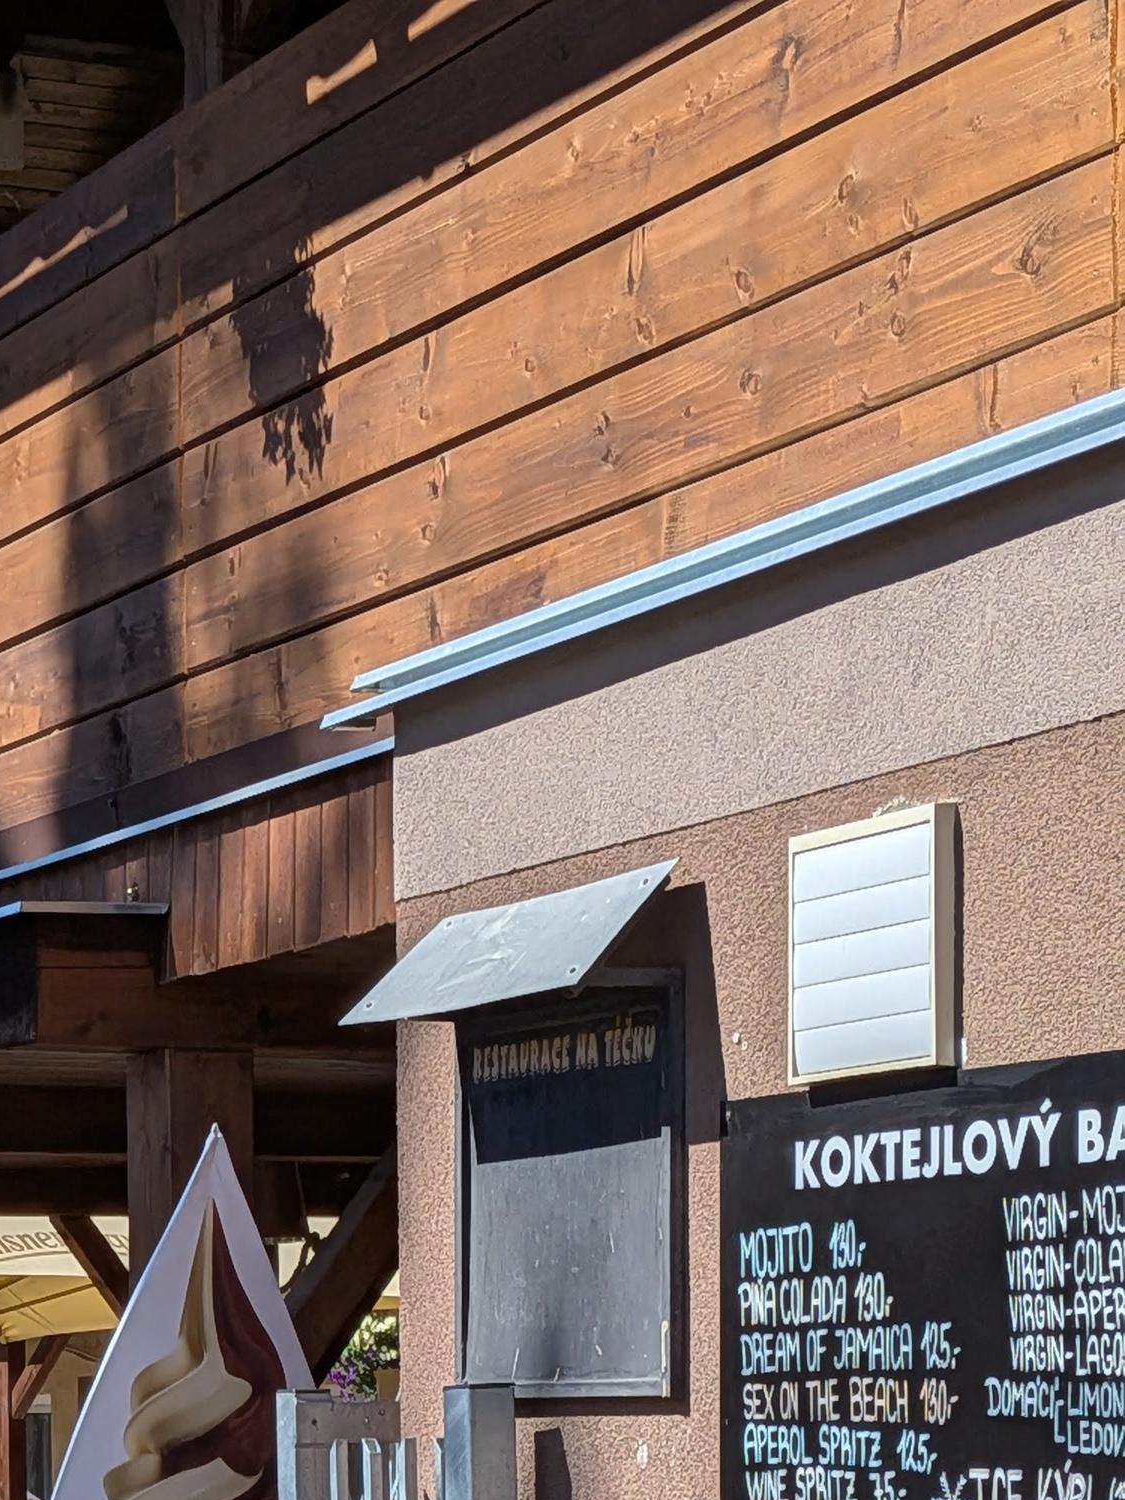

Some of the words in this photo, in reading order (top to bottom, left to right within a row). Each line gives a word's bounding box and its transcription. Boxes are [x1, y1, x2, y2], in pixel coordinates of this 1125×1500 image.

[472, 1033, 571, 1085] RESTAURACE
[575, 1032, 600, 1071] NA
[794, 1097, 1063, 1190] KOKTEJLOVÝ
[739, 1221, 813, 1279] MOJITO
[779, 1274, 847, 1327] COLADA
[739, 1331, 801, 1376] DREAM
[806, 1328, 828, 1372] OF
[833, 1322, 913, 1372] JAMAICA
[742, 1381, 774, 1420] SEX
[779, 1380, 799, 1420] ON
[805, 1377, 841, 1423] THE
[849, 1376, 909, 1424] BEACH
[743, 1421, 813, 1467] APEROL
[818, 1423, 883, 1468] SPRITZ
[1067, 1419, 1125, 1457] LEDOV
